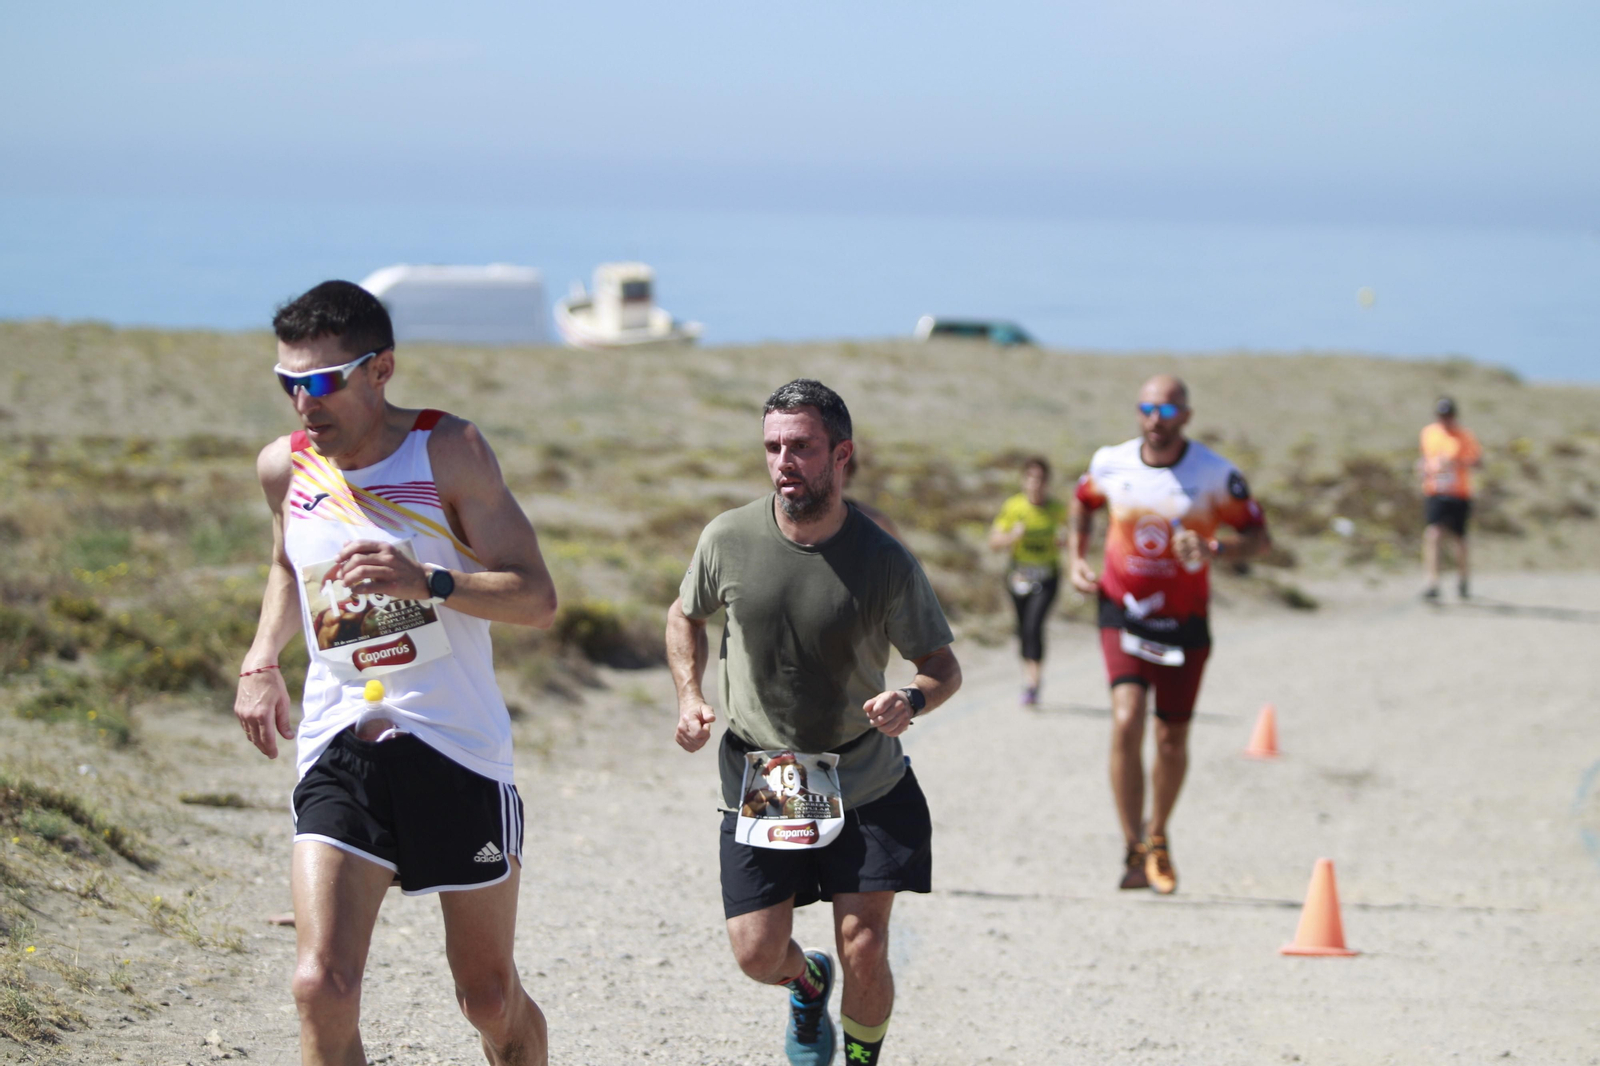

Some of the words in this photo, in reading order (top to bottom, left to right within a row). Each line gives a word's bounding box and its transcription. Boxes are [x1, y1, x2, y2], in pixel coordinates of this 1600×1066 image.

[376, 606, 421, 620] CARRERA
[358, 642, 410, 663] Caparrós
[766, 765, 801, 797] 49
[794, 793, 829, 803] XIII
[474, 853, 503, 862] adidas
